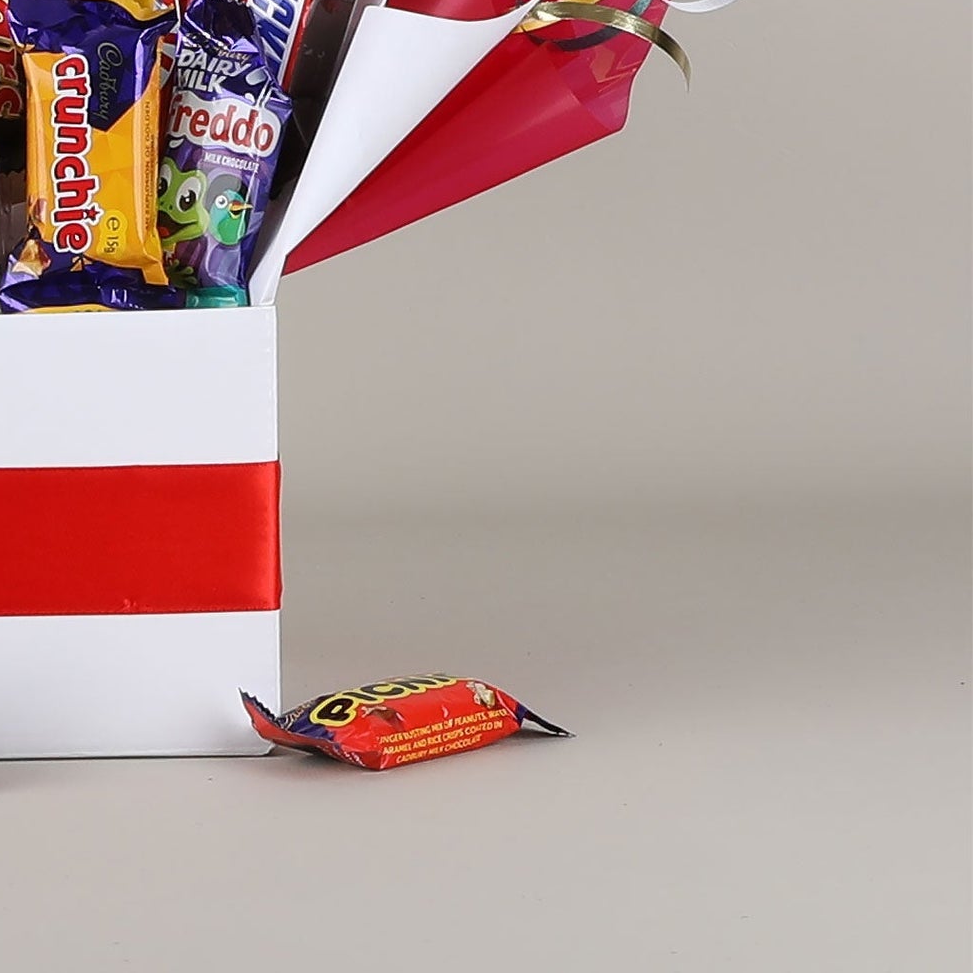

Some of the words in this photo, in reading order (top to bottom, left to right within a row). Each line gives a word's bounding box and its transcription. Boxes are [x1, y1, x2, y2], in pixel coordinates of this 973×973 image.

[94, 42, 123, 121] Cadbury
[178, 49, 251, 77] DAIRY
[54, 57, 97, 250] crunchie
[204, 152, 221, 164] MILK
[222, 156, 260, 173] CHOCOLATE
